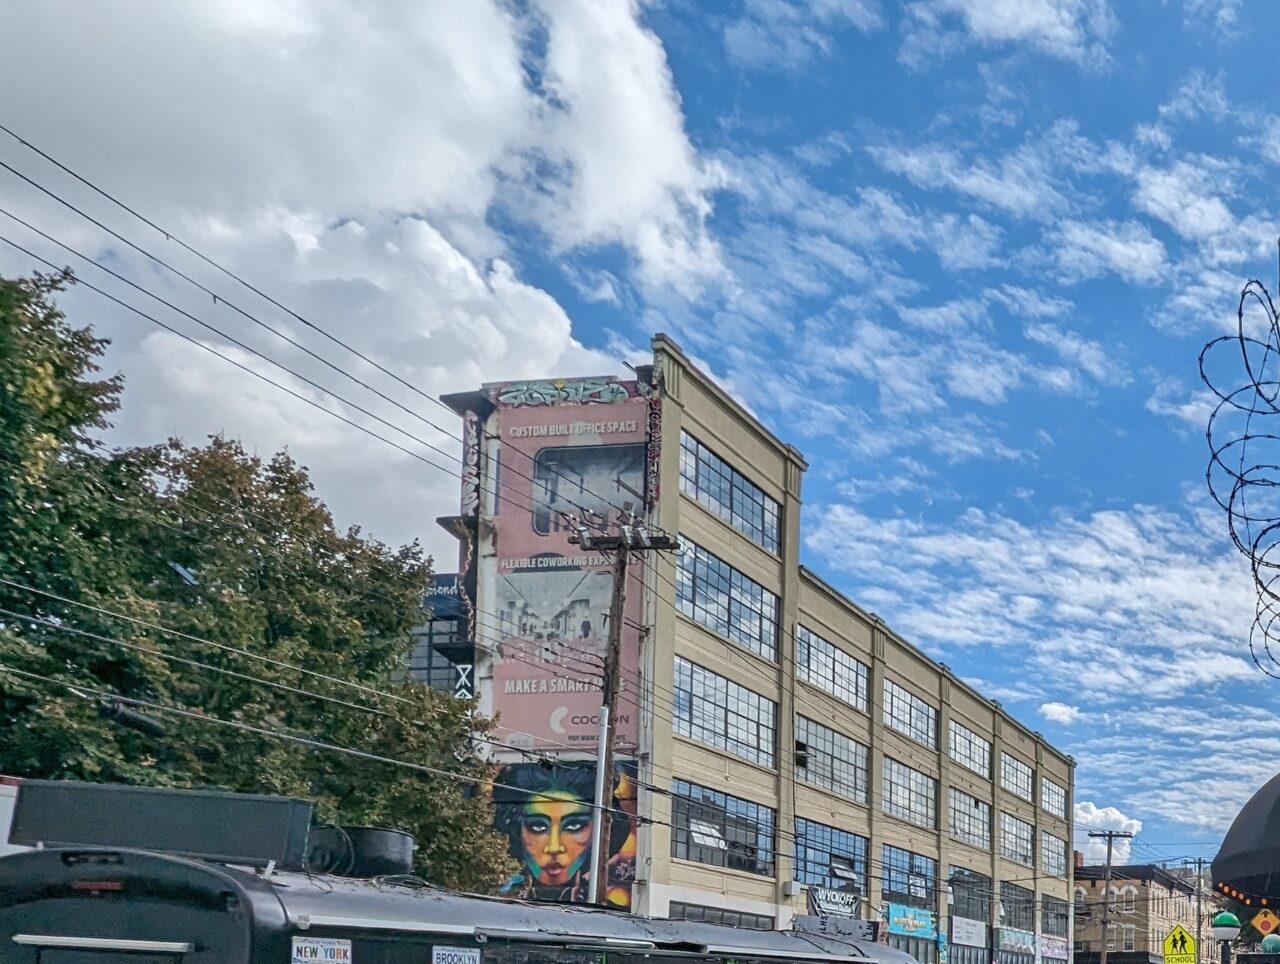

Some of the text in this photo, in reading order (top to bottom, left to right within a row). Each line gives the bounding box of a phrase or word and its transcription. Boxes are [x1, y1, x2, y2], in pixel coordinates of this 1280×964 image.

[510, 420, 637, 438] CUSTOM BUILT OFFICE SPACE
[501, 558, 536, 569] FLEXIBLE
[537, 556, 587, 568] COWORKING
[504, 679, 538, 694] MAKE
[540, 679, 548, 693] A
[550, 678, 590, 692] SMART
[818, 888, 854, 905] WYCKOFF
[296, 946, 348, 960] NEW YORK
[1165, 955, 1194, 964] SCHOOL
